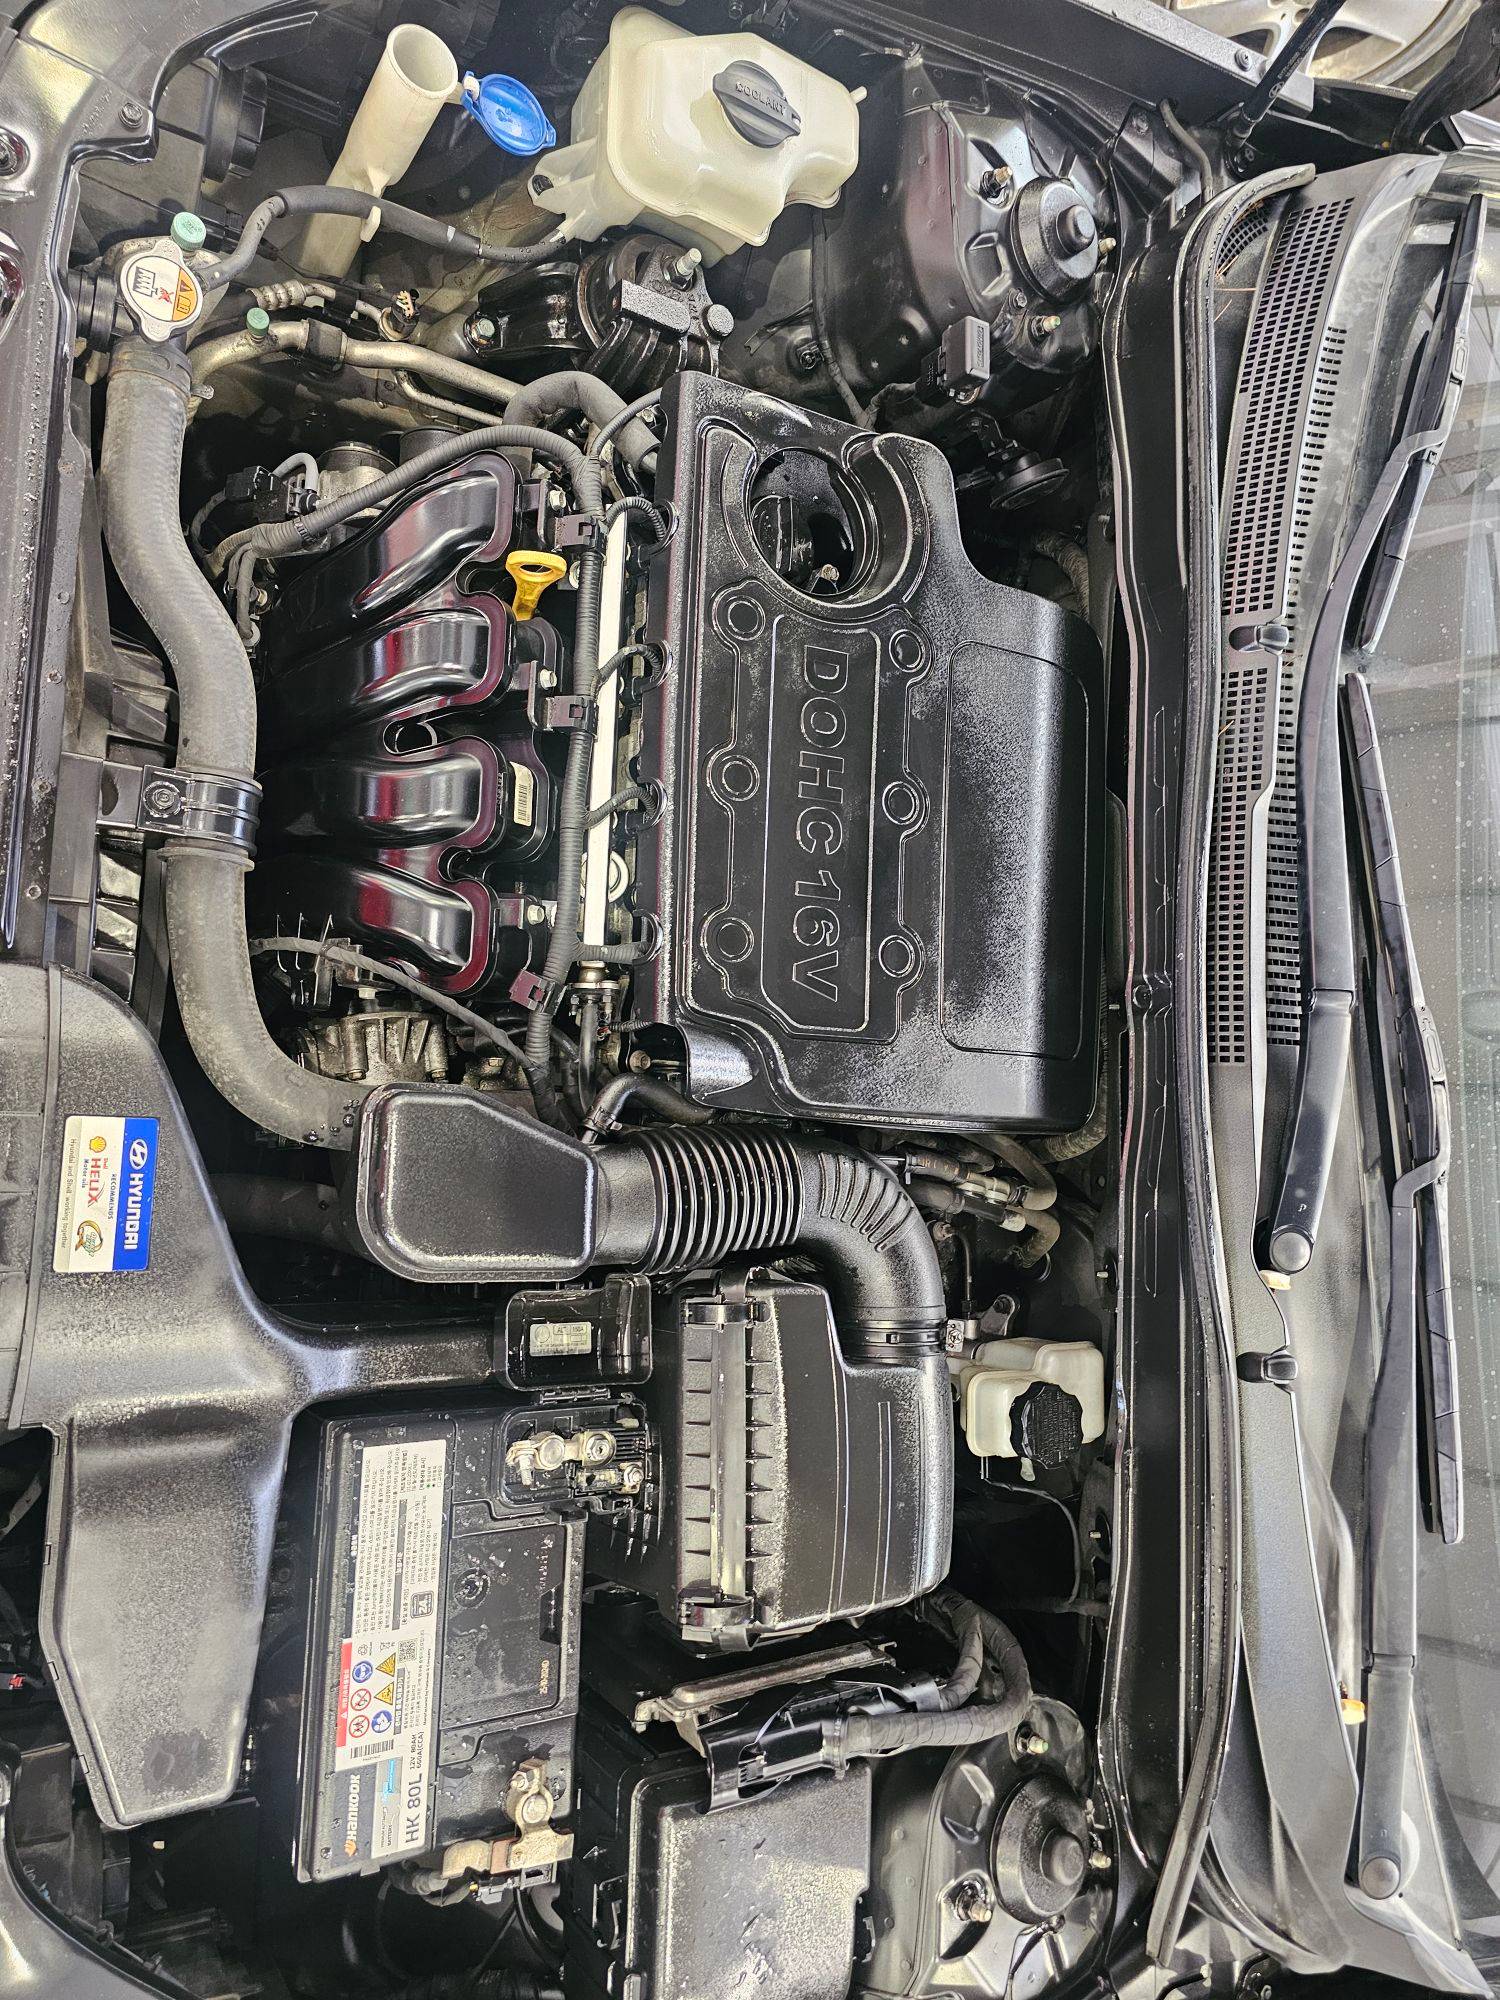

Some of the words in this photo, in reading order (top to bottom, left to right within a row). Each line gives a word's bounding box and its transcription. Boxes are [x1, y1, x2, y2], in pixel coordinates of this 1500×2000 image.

[736, 82, 786, 116] COOLANT
[795, 644, 849, 856] DOHC
[791, 869, 841, 1002] 16V
[67, 1138, 77, 1164] Hyundai
[81, 1158, 90, 1176] Motor
[65, 1178, 74, 1194] Shell
[66, 1165, 75, 1176] and
[87, 1157, 102, 1208] HELIX
[62, 1196, 72, 1221] working
[107, 1173, 117, 1220] RECOMMENDS
[123, 1173, 144, 1250] HYUNDAI
[60, 1222, 71, 1249] together
[407, 1773, 422, 1809] 80L
[405, 1813, 420, 1843] HK
